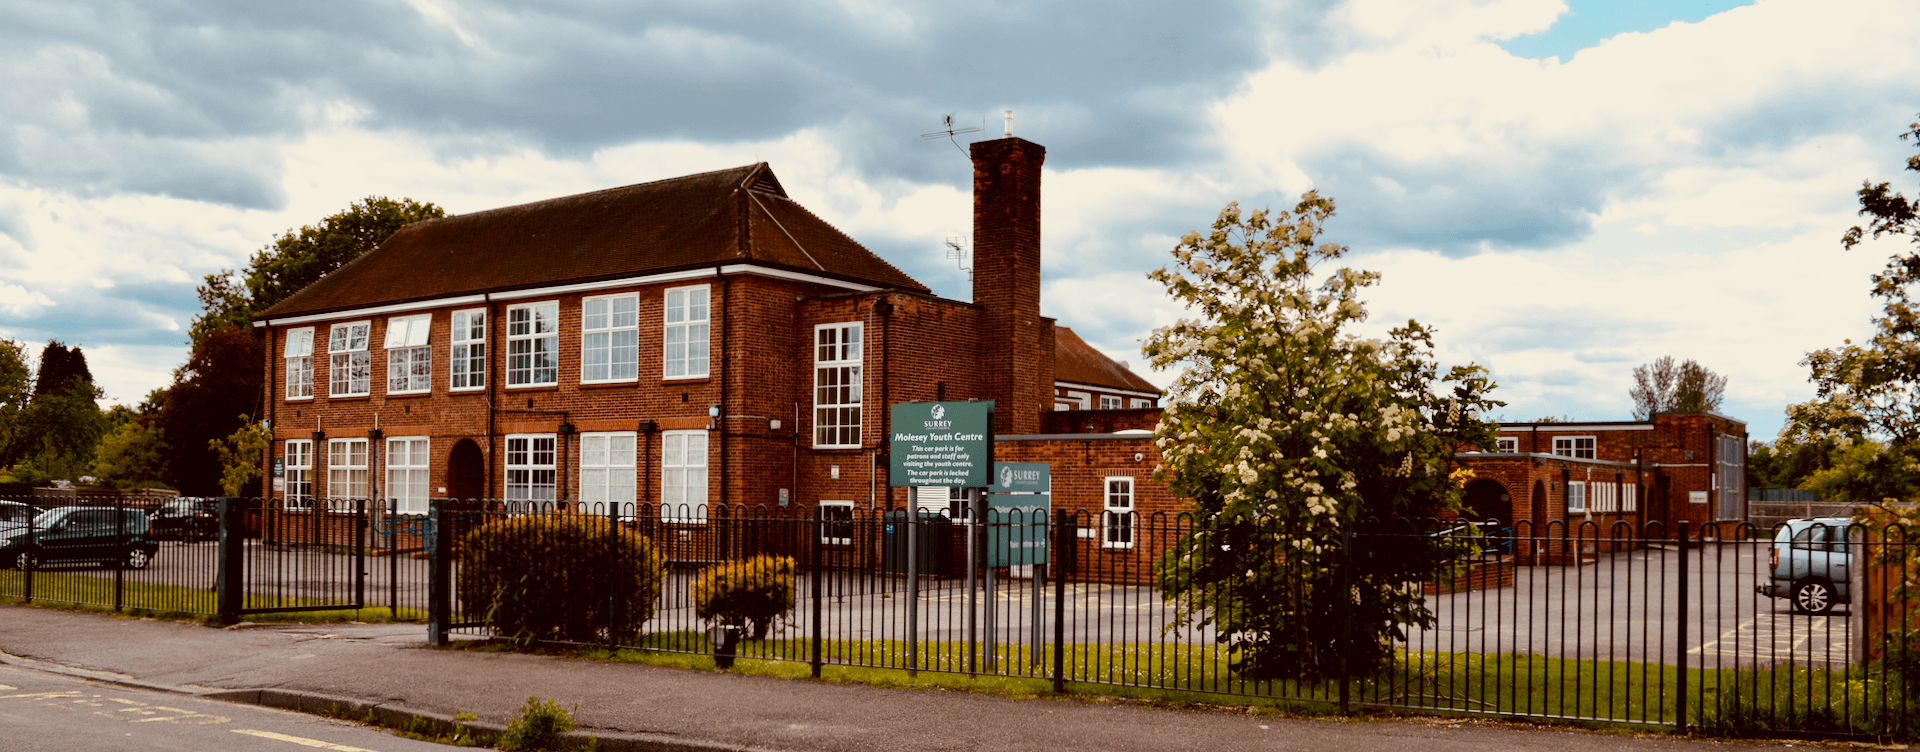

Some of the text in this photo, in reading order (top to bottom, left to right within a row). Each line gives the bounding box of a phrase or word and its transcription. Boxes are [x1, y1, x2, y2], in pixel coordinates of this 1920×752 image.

[894, 432, 983, 443] Molesey Youth Centre
[934, 445, 948, 453] park
[1014, 470, 1040, 480] SURREY
